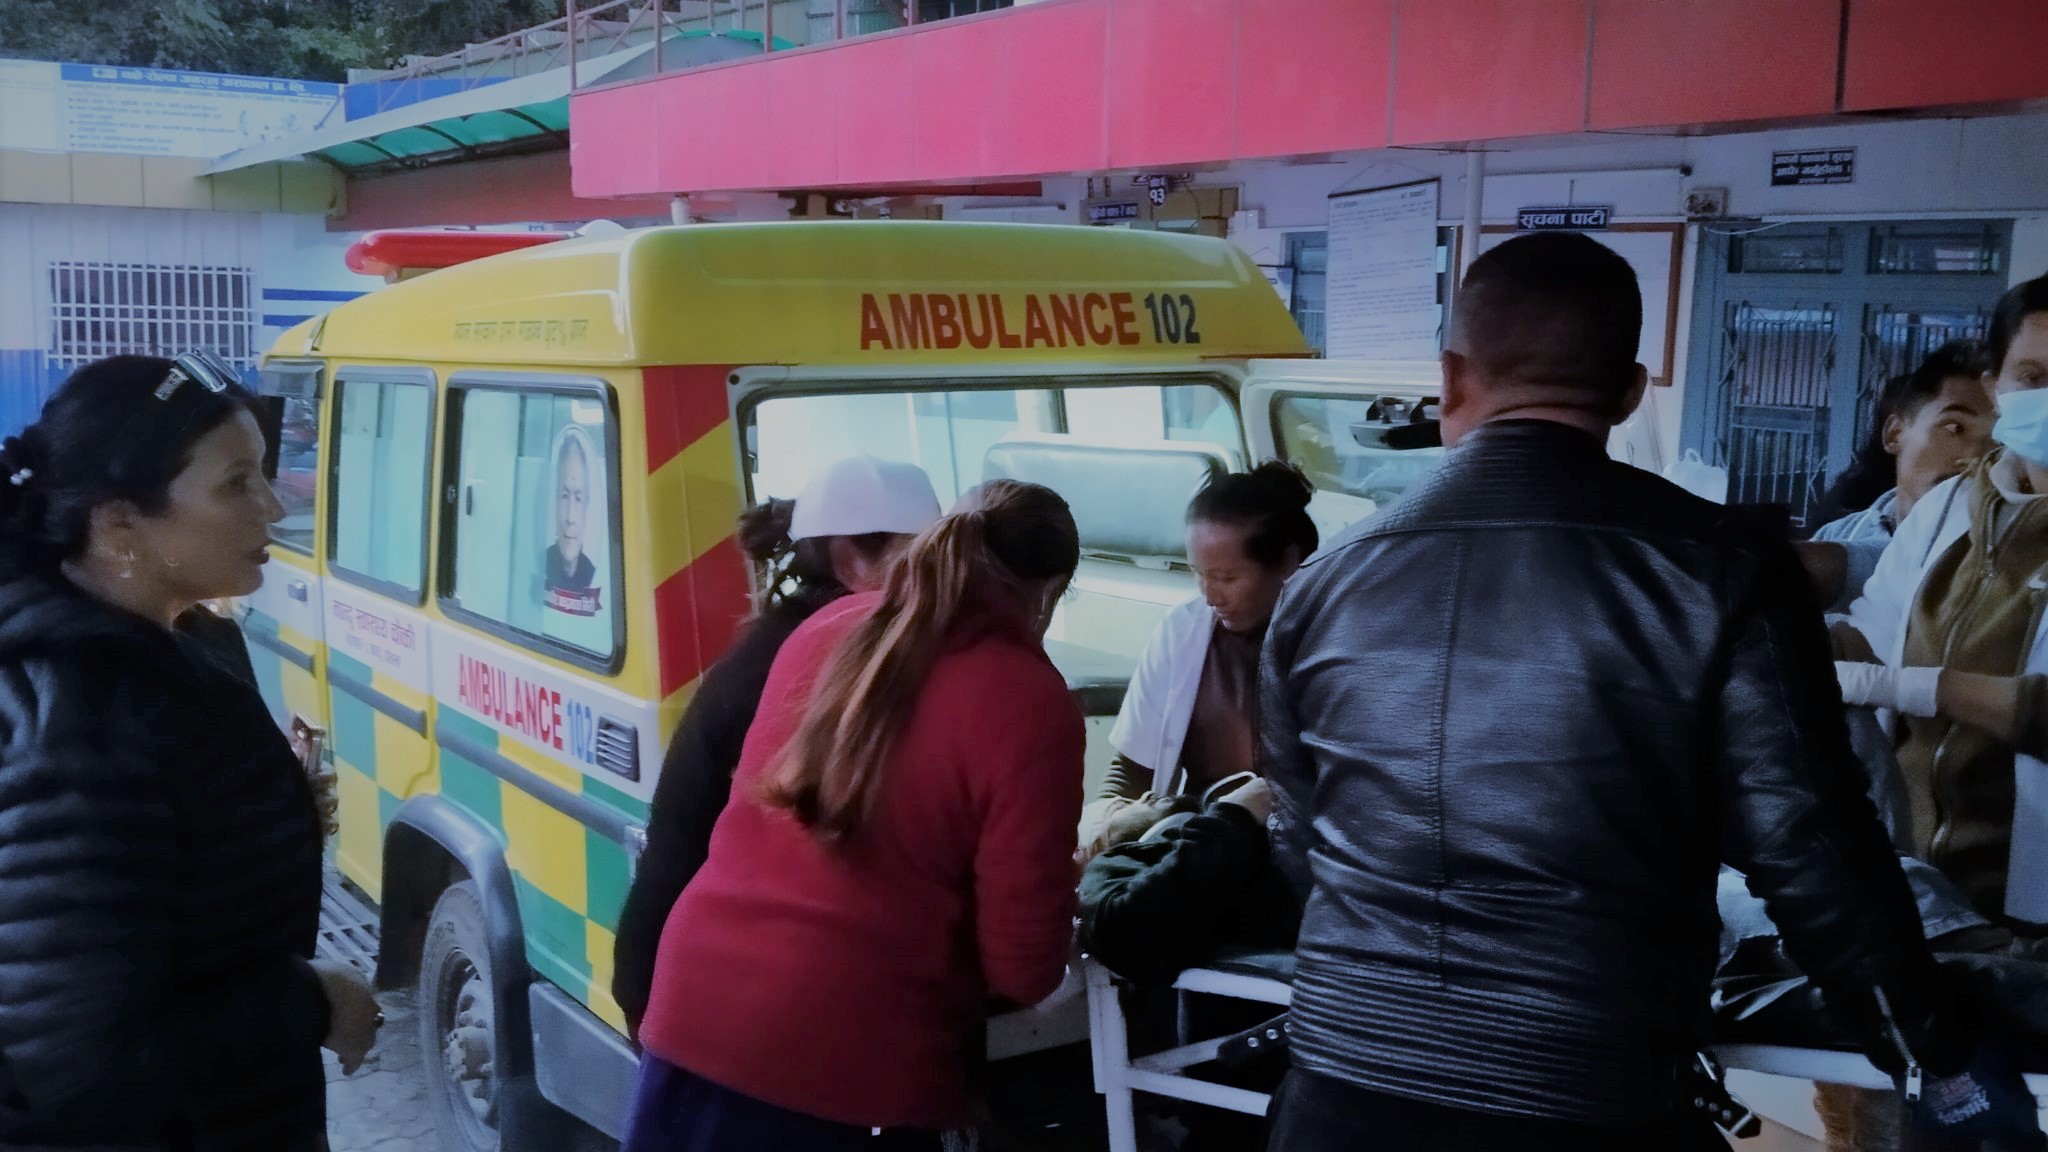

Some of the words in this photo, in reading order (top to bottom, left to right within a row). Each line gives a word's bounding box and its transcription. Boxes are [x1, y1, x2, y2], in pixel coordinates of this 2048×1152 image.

[1520, 213, 1566, 229] सूचना
[1571, 209, 1605, 225] पाटी
[860, 292, 1141, 350] AMBULANCE
[1144, 292, 1201, 344] 102
[459, 653, 564, 751] AMBULANCE
[567, 698, 595, 765] 102
